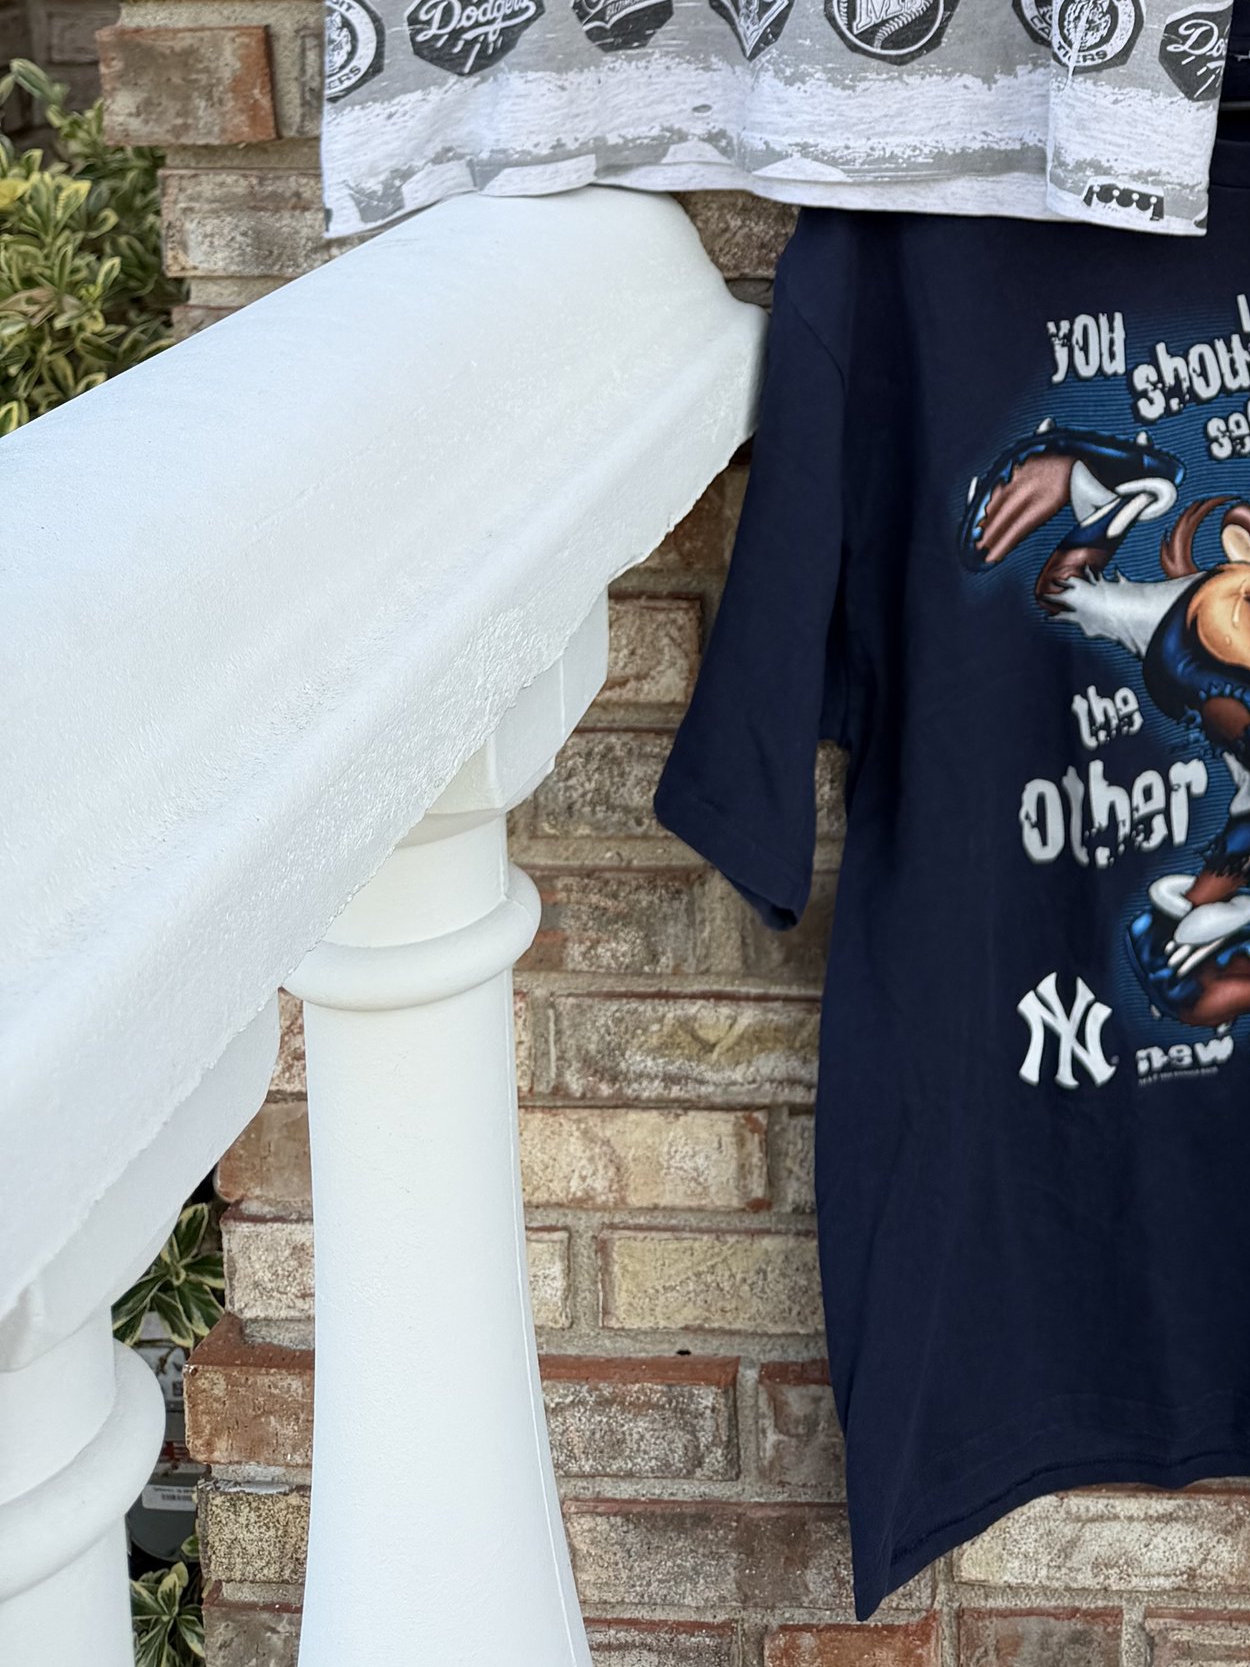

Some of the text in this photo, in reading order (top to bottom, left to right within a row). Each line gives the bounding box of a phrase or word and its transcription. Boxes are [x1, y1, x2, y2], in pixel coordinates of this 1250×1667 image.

[1047, 312, 1126, 383] you
[1071, 685, 1144, 750] the
[1135, 1035, 1234, 1076] new
